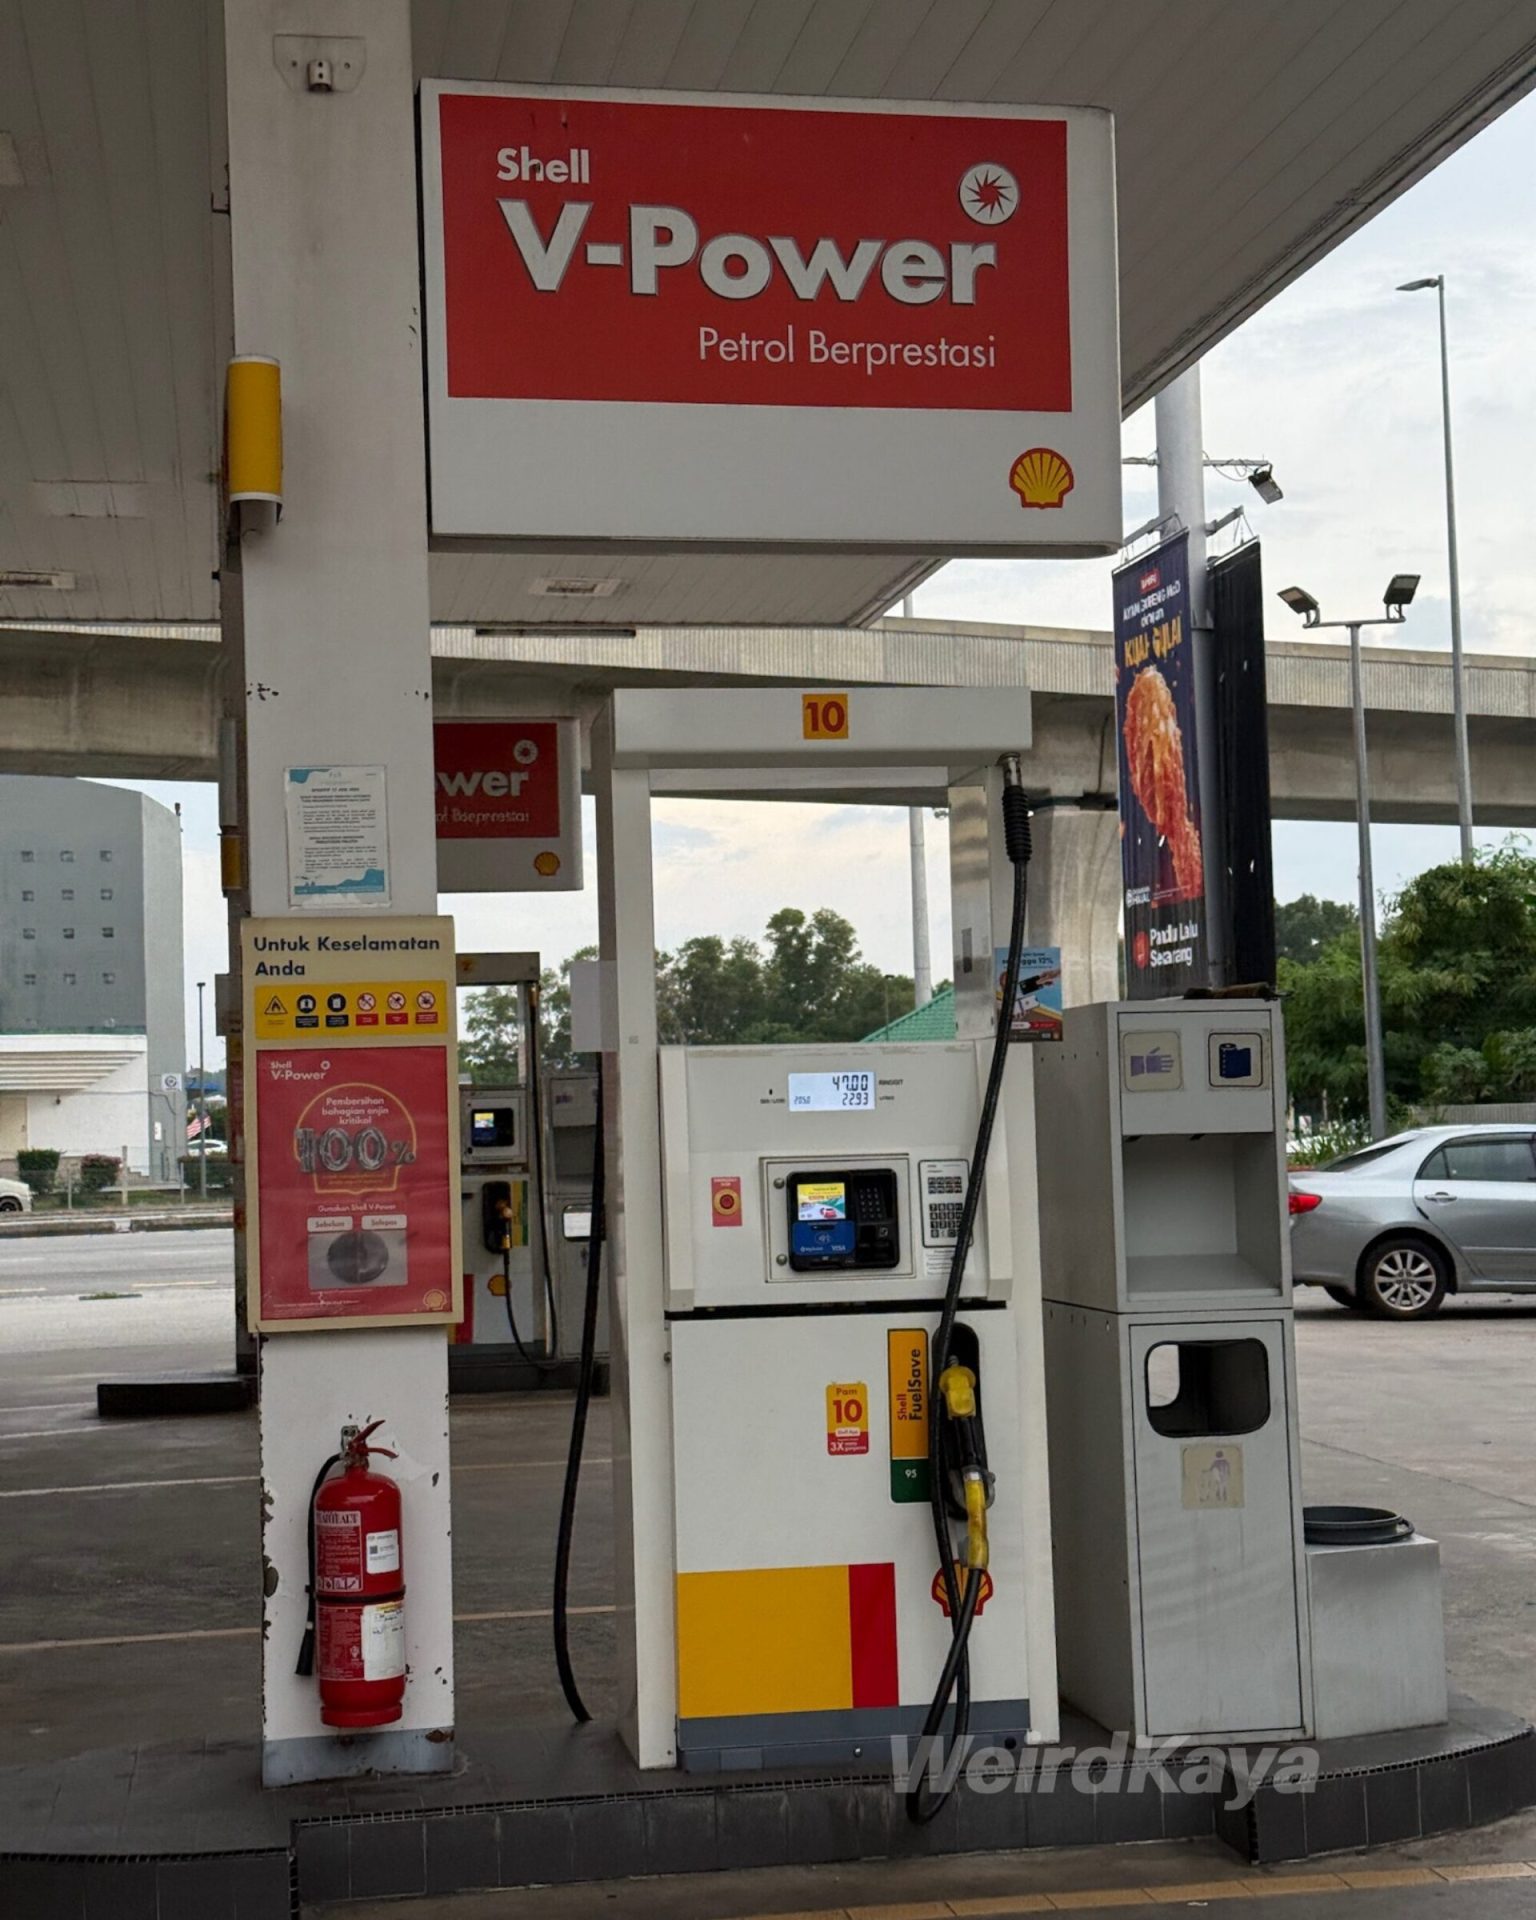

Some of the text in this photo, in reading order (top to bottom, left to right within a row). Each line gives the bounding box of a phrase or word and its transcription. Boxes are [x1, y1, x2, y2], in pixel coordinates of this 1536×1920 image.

[497, 148, 590, 185] Shell
[498, 198, 997, 306] V-Power
[699, 325, 996, 376] Petrol Berprestasi
[805, 701, 846, 733] 10
[433, 771, 529, 797] wer
[1179, 919, 1199, 941] Lalu
[254, 935, 440, 952] Untuk Keselamatan
[255, 960, 306, 977] Anda
[270, 1060, 293, 1070] Shell
[271, 1070, 327, 1081] V-Power
[326, 1096, 385, 1107] Pembersihan
[322, 1106, 389, 1117] bahagian enjin
[339, 1115, 372, 1125] kritikal
[836, 1388, 858, 1396] Pam
[907, 1348, 923, 1421] FuelSave
[833, 1399, 863, 1424] 10
[896, 1393, 907, 1421] Shell
[904, 1469, 917, 1479] 95
